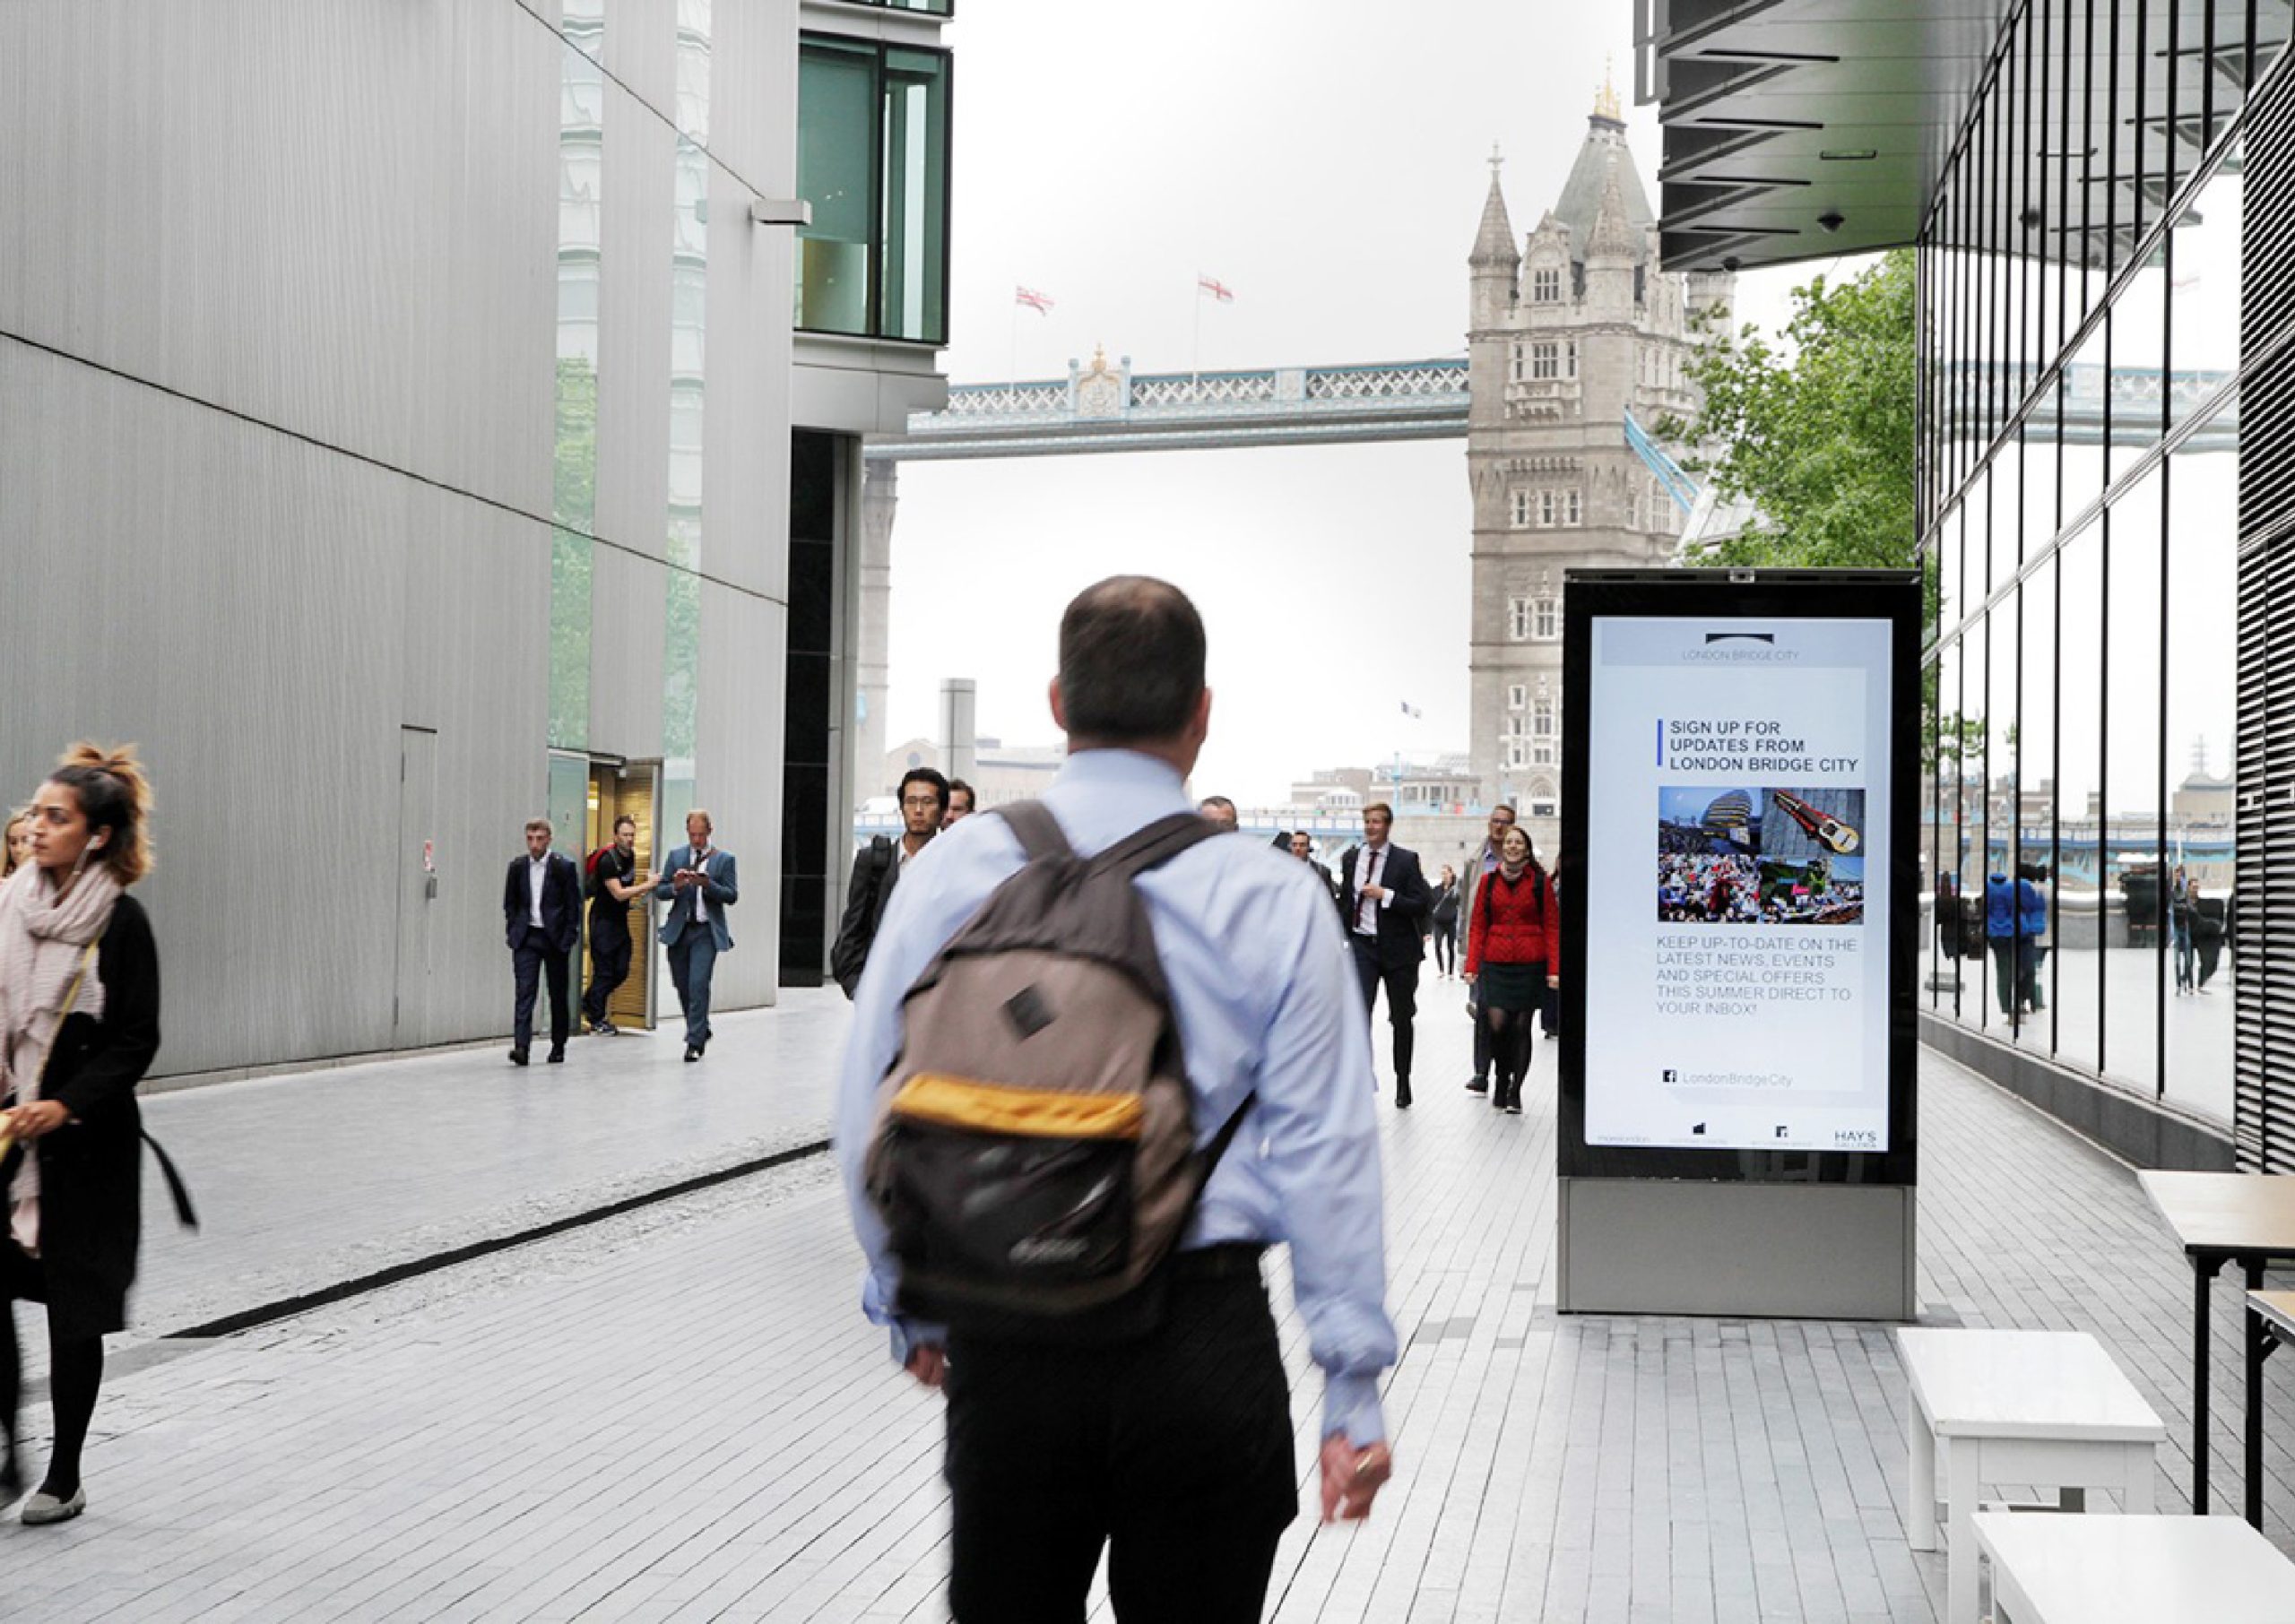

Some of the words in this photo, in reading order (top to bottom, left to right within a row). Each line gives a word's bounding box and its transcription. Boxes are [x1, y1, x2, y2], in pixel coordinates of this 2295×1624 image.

[1670, 721, 1711, 734] SIGN
[1717, 721, 1740, 735] UP
[1745, 721, 1780, 735] FOR
[1670, 739, 1748, 753] UPDATES
[1755, 739, 1805, 753] FROM
[1670, 757, 1743, 771] LONDON
[1749, 757, 1814, 772] BRIDGE
[1819, 758, 1858, 772] CITY
[1657, 936, 1698, 949] KEEP
[1702, 937, 1794, 950] UP-TO-DATE
[1798, 937, 1823, 951] ON
[1828, 938, 1858, 952] THE
[1657, 953, 1712, 965] LATEST
[1717, 953, 1769, 967] NEWS,
[1771, 954, 1835, 968] EVENTS
[1657, 969, 1690, 981] AND
[1693, 969, 1758, 983] SPECIAL
[1762, 971, 1825, 985] OFFERS
[1657, 985, 1692, 998] THIS
[1695, 985, 1765, 1000] SUMMER
[1769, 988, 1825, 1000] DIRECT
[1831, 988, 1852, 1001] TO
[1657, 1001, 1701, 1015] YOUR
[1705, 1002, 1757, 1015] INBOX!
